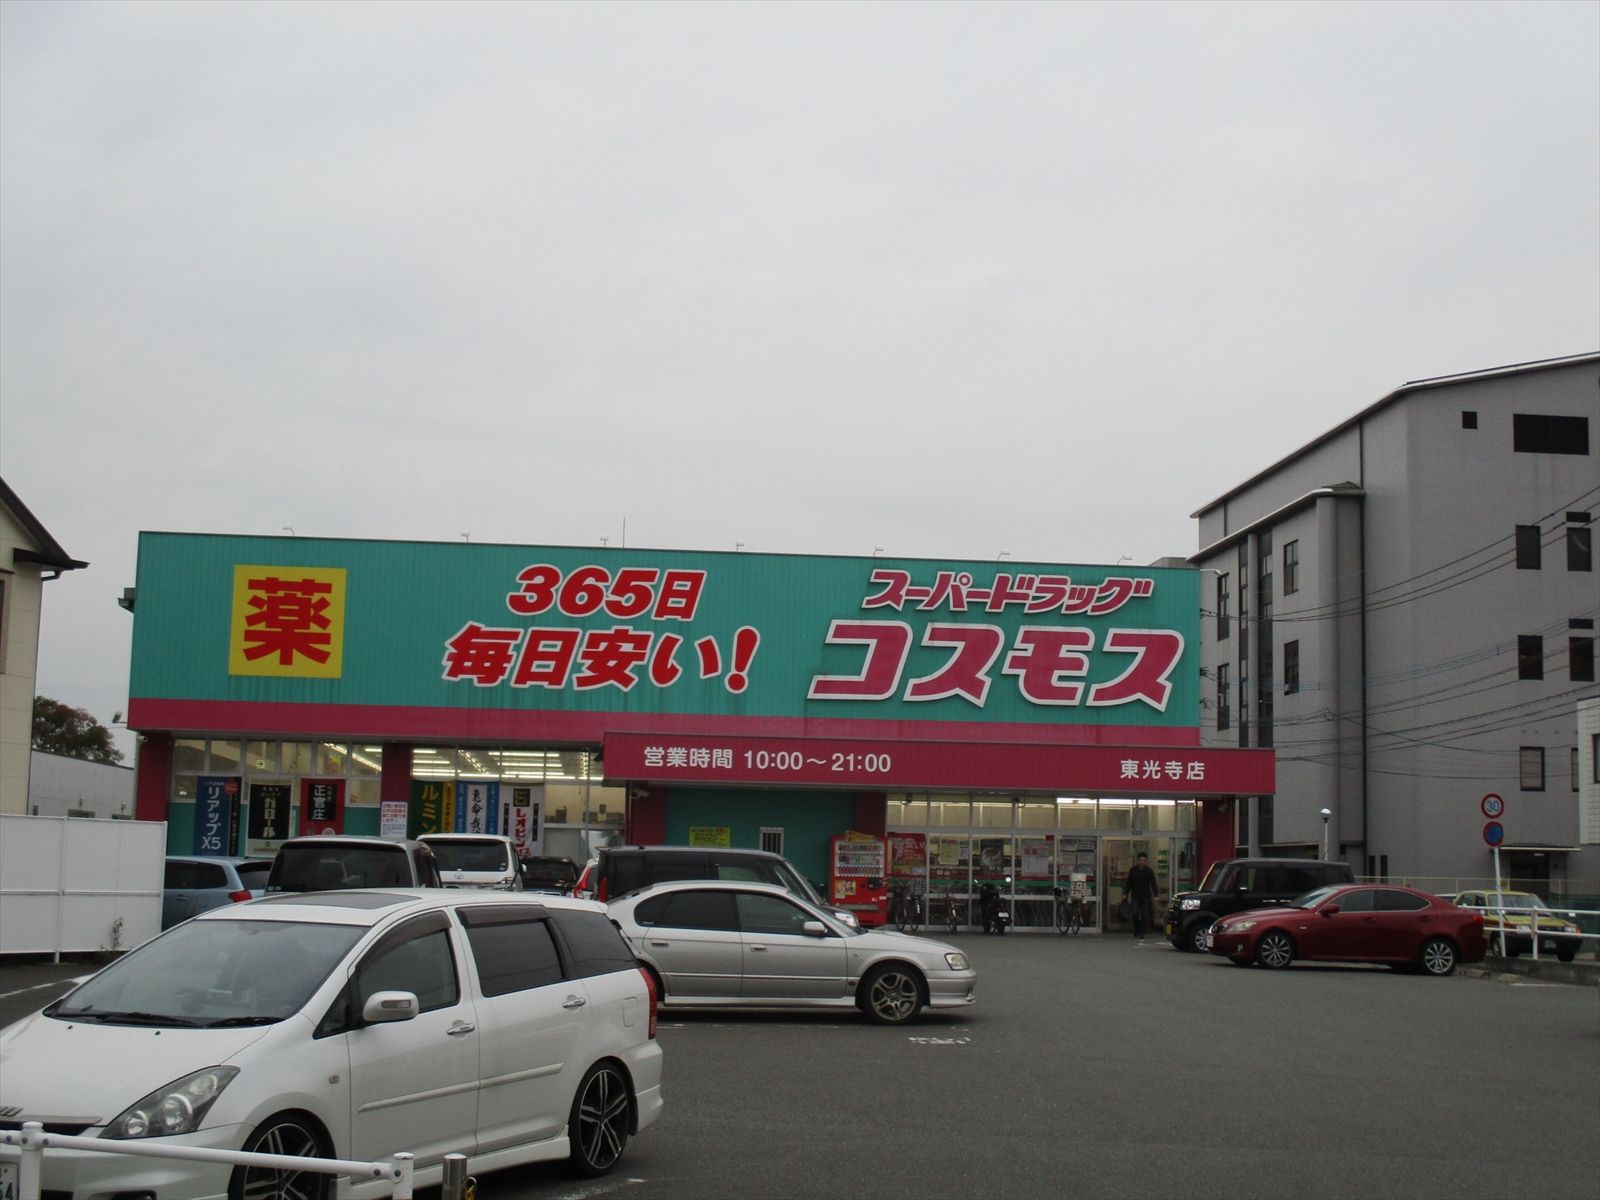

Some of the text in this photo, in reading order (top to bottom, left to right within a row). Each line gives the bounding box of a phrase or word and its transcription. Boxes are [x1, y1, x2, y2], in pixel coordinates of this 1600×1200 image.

[507, 564, 706, 619] 365日
[862, 569, 1155, 616] スーパードラッグ
[244, 577, 332, 666] 薬
[442, 621, 761, 694] 毎日安い!
[806, 618, 1186, 713] コスモス
[644, 746, 733, 769] 営業時間
[1120, 759, 1206, 780] 東光寺店
[1487, 800, 1500, 812] 30
